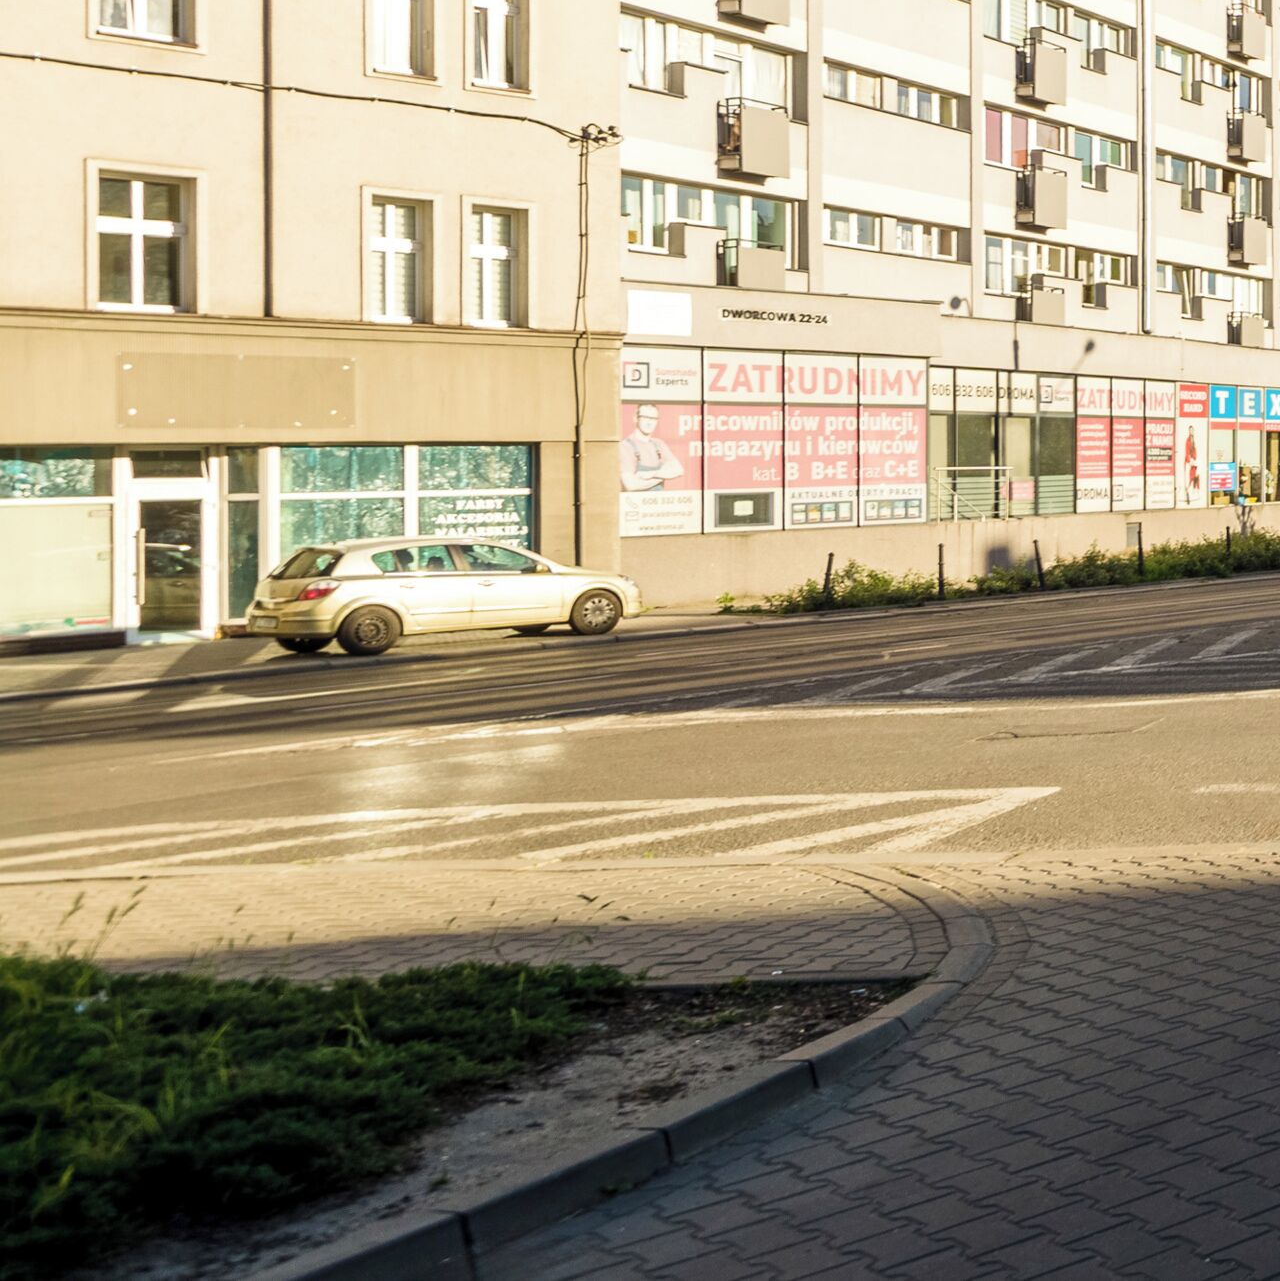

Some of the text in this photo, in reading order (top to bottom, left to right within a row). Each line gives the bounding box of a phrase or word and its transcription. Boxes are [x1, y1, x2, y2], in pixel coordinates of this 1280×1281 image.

[722, 309, 828, 323] DWORCOWA 22-24
[708, 363, 924, 396] ZATRUDNIMY
[932, 384, 951, 396] 606
[976, 385, 994, 398] 606
[679, 410, 919, 437] pracowników produkcji,
[689, 434, 919, 461] magazynu i kierowców
[811, 461, 848, 480] B+E
[884, 460, 919, 478] C+E
[791, 490, 843, 499] AKTUALNE
